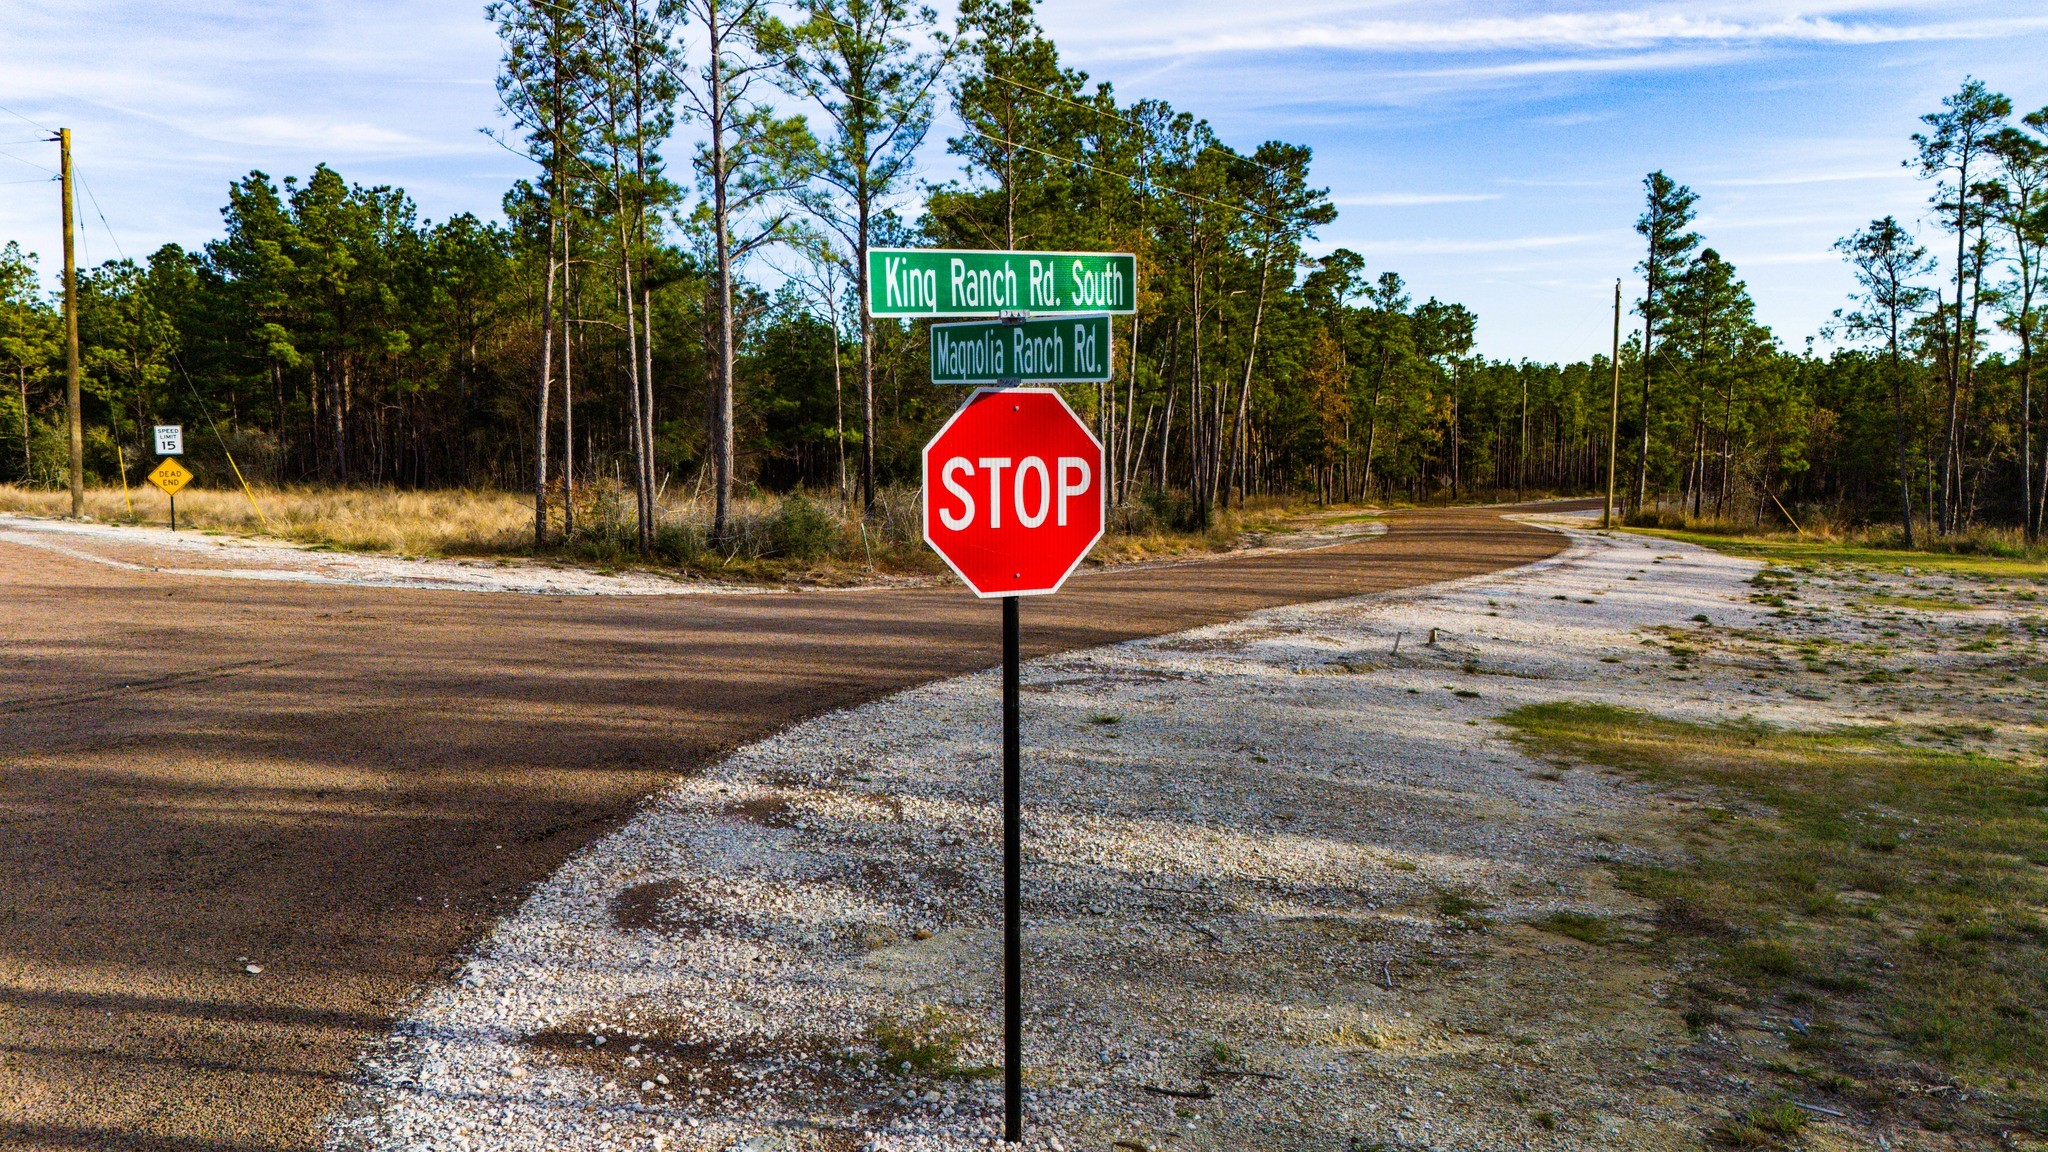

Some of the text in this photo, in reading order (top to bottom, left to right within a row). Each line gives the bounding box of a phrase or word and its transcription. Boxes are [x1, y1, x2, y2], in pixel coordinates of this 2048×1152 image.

[885, 256, 1123, 312] King Ranch Rd. South
[937, 323, 1101, 380] Magnolia Ranch Rd.
[162, 441, 176, 450] 15
[939, 456, 1091, 531] STOP
